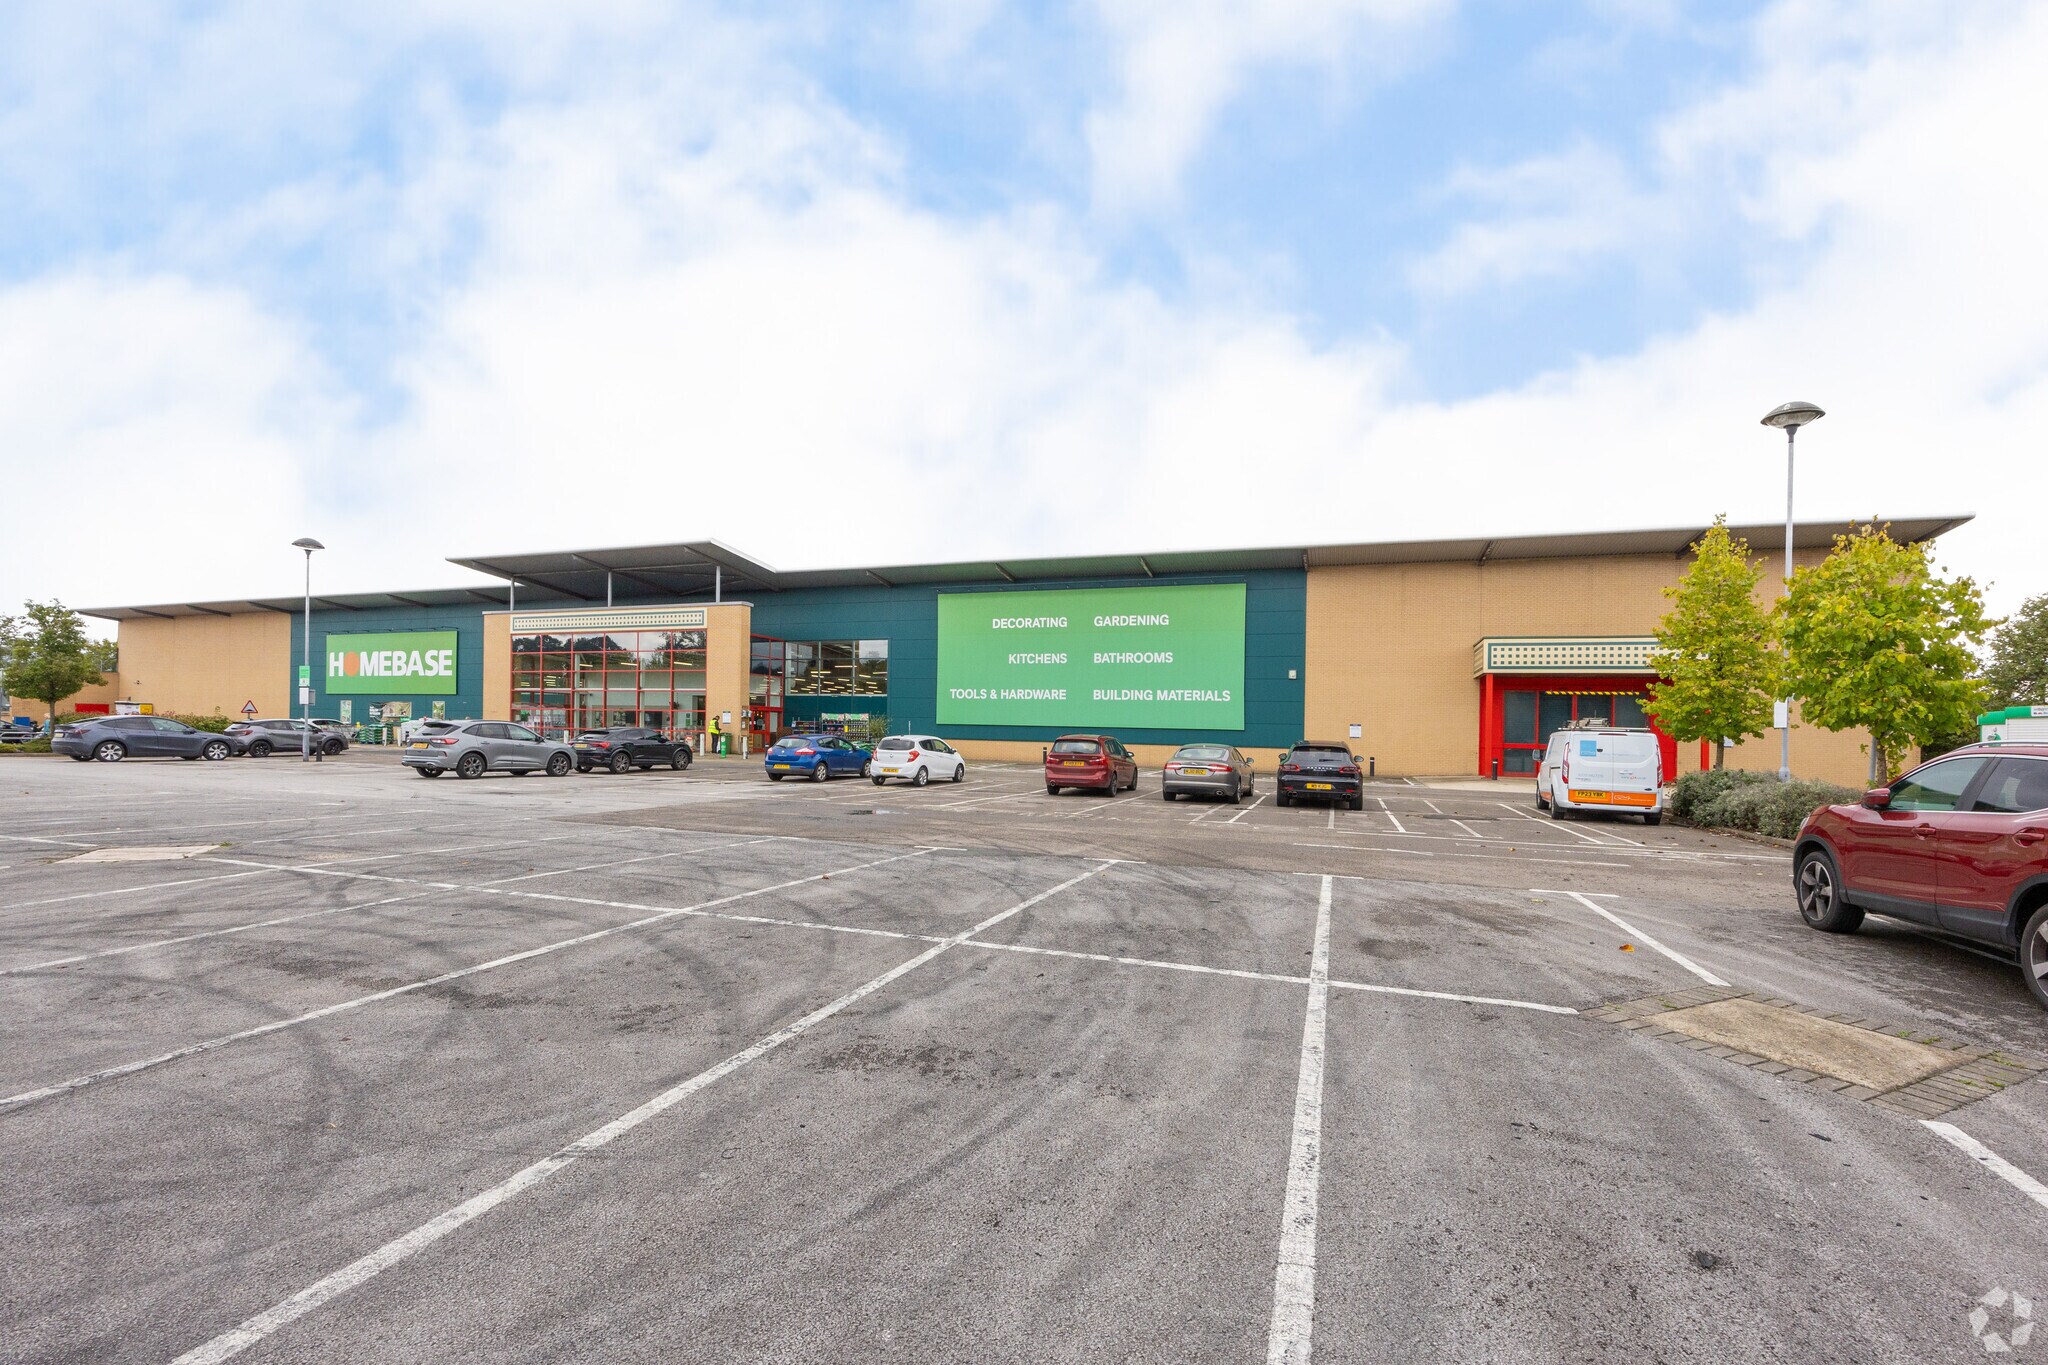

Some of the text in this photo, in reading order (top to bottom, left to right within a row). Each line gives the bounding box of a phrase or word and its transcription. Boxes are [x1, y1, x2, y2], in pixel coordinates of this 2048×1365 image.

[991, 616, 1068, 630] DECORATING
[1093, 613, 1170, 627] GARDENING
[328, 649, 454, 678] HOMEBASE
[1008, 652, 1068, 665] KITCHENS
[1093, 651, 1174, 664] BATHROOMS
[949, 688, 1067, 701] TOOLS & HARDWARE
[1092, 688, 1231, 702] BUILDING MATERIALS
